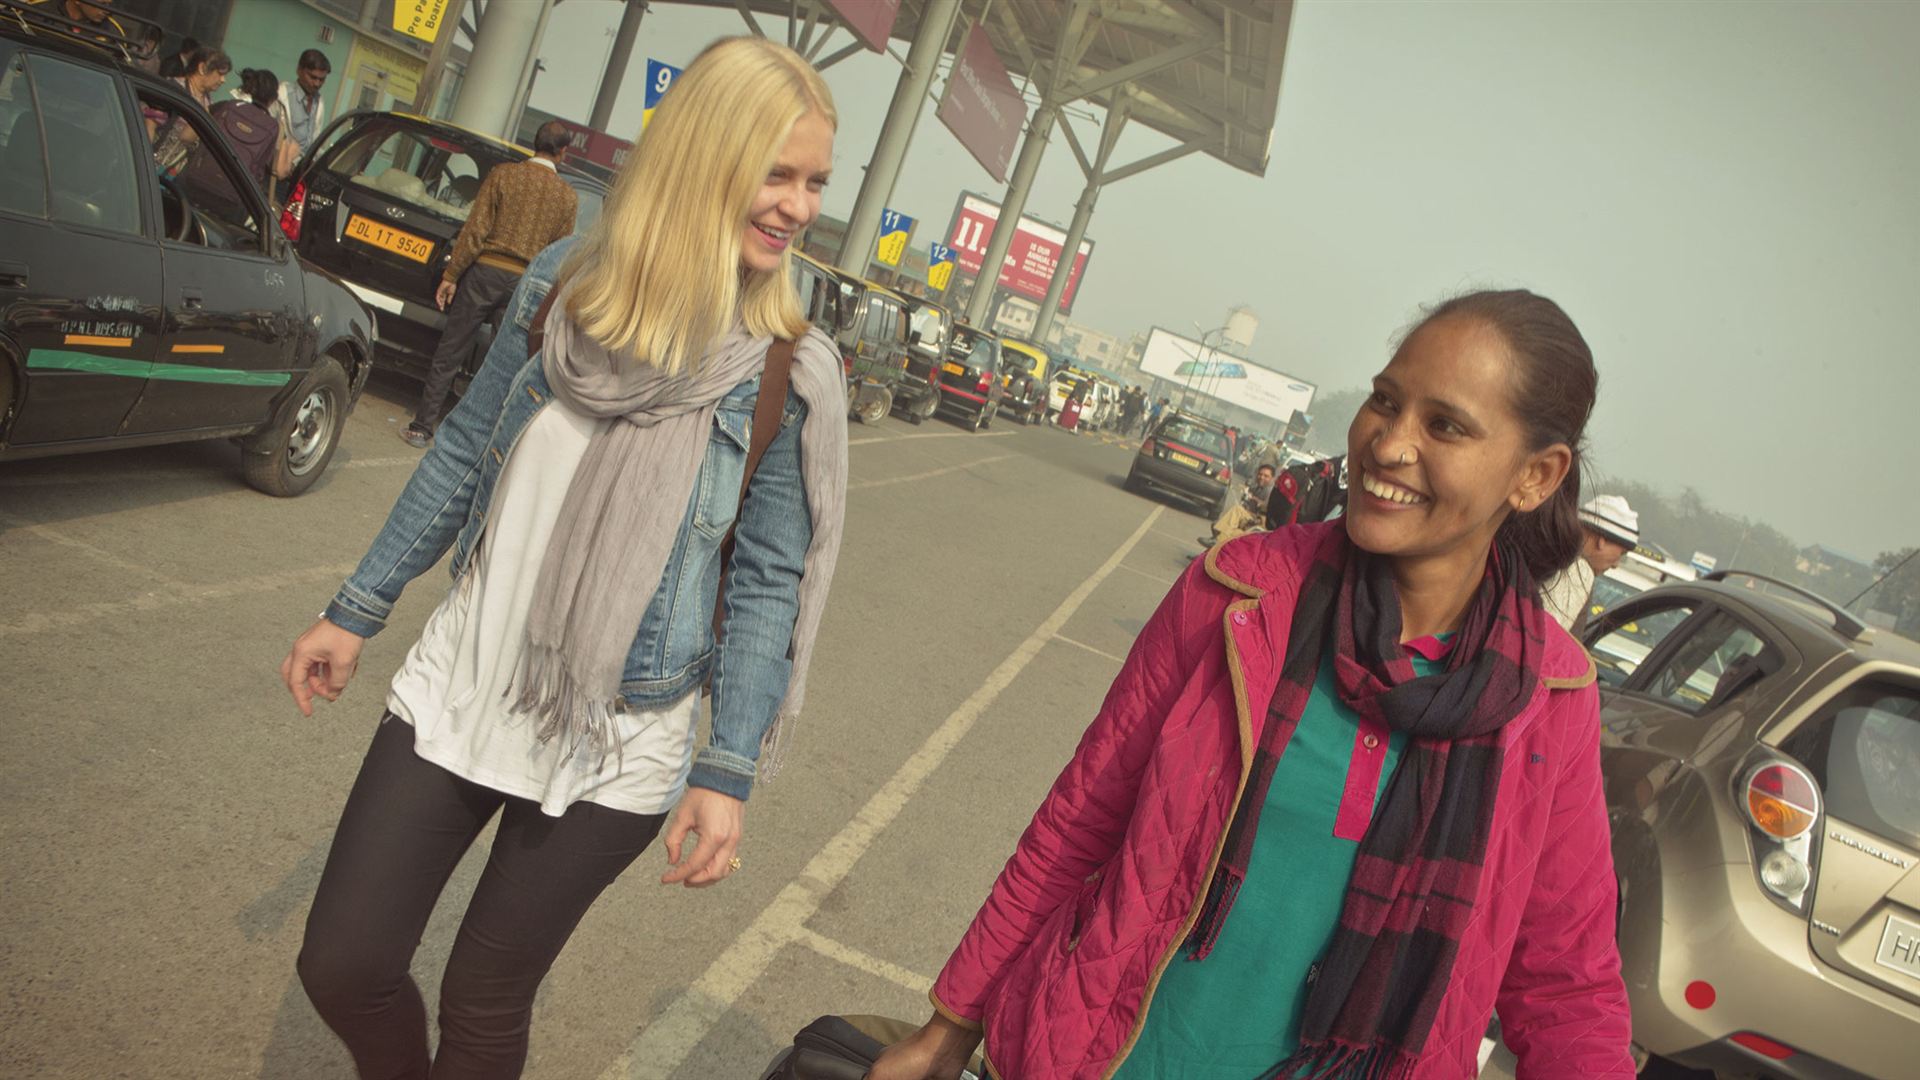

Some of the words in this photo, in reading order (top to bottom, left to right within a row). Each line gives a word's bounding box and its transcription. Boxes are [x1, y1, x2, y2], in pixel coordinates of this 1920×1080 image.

[407, 16, 421, 35] Pre
[655, 67, 672, 93] 9
[885, 211, 900, 229] 11
[356, 221, 370, 238] DL
[396, 236, 428, 258] 9540
[933, 245, 948, 260] 12
[1830, 831, 1909, 869] CHEVROLET
